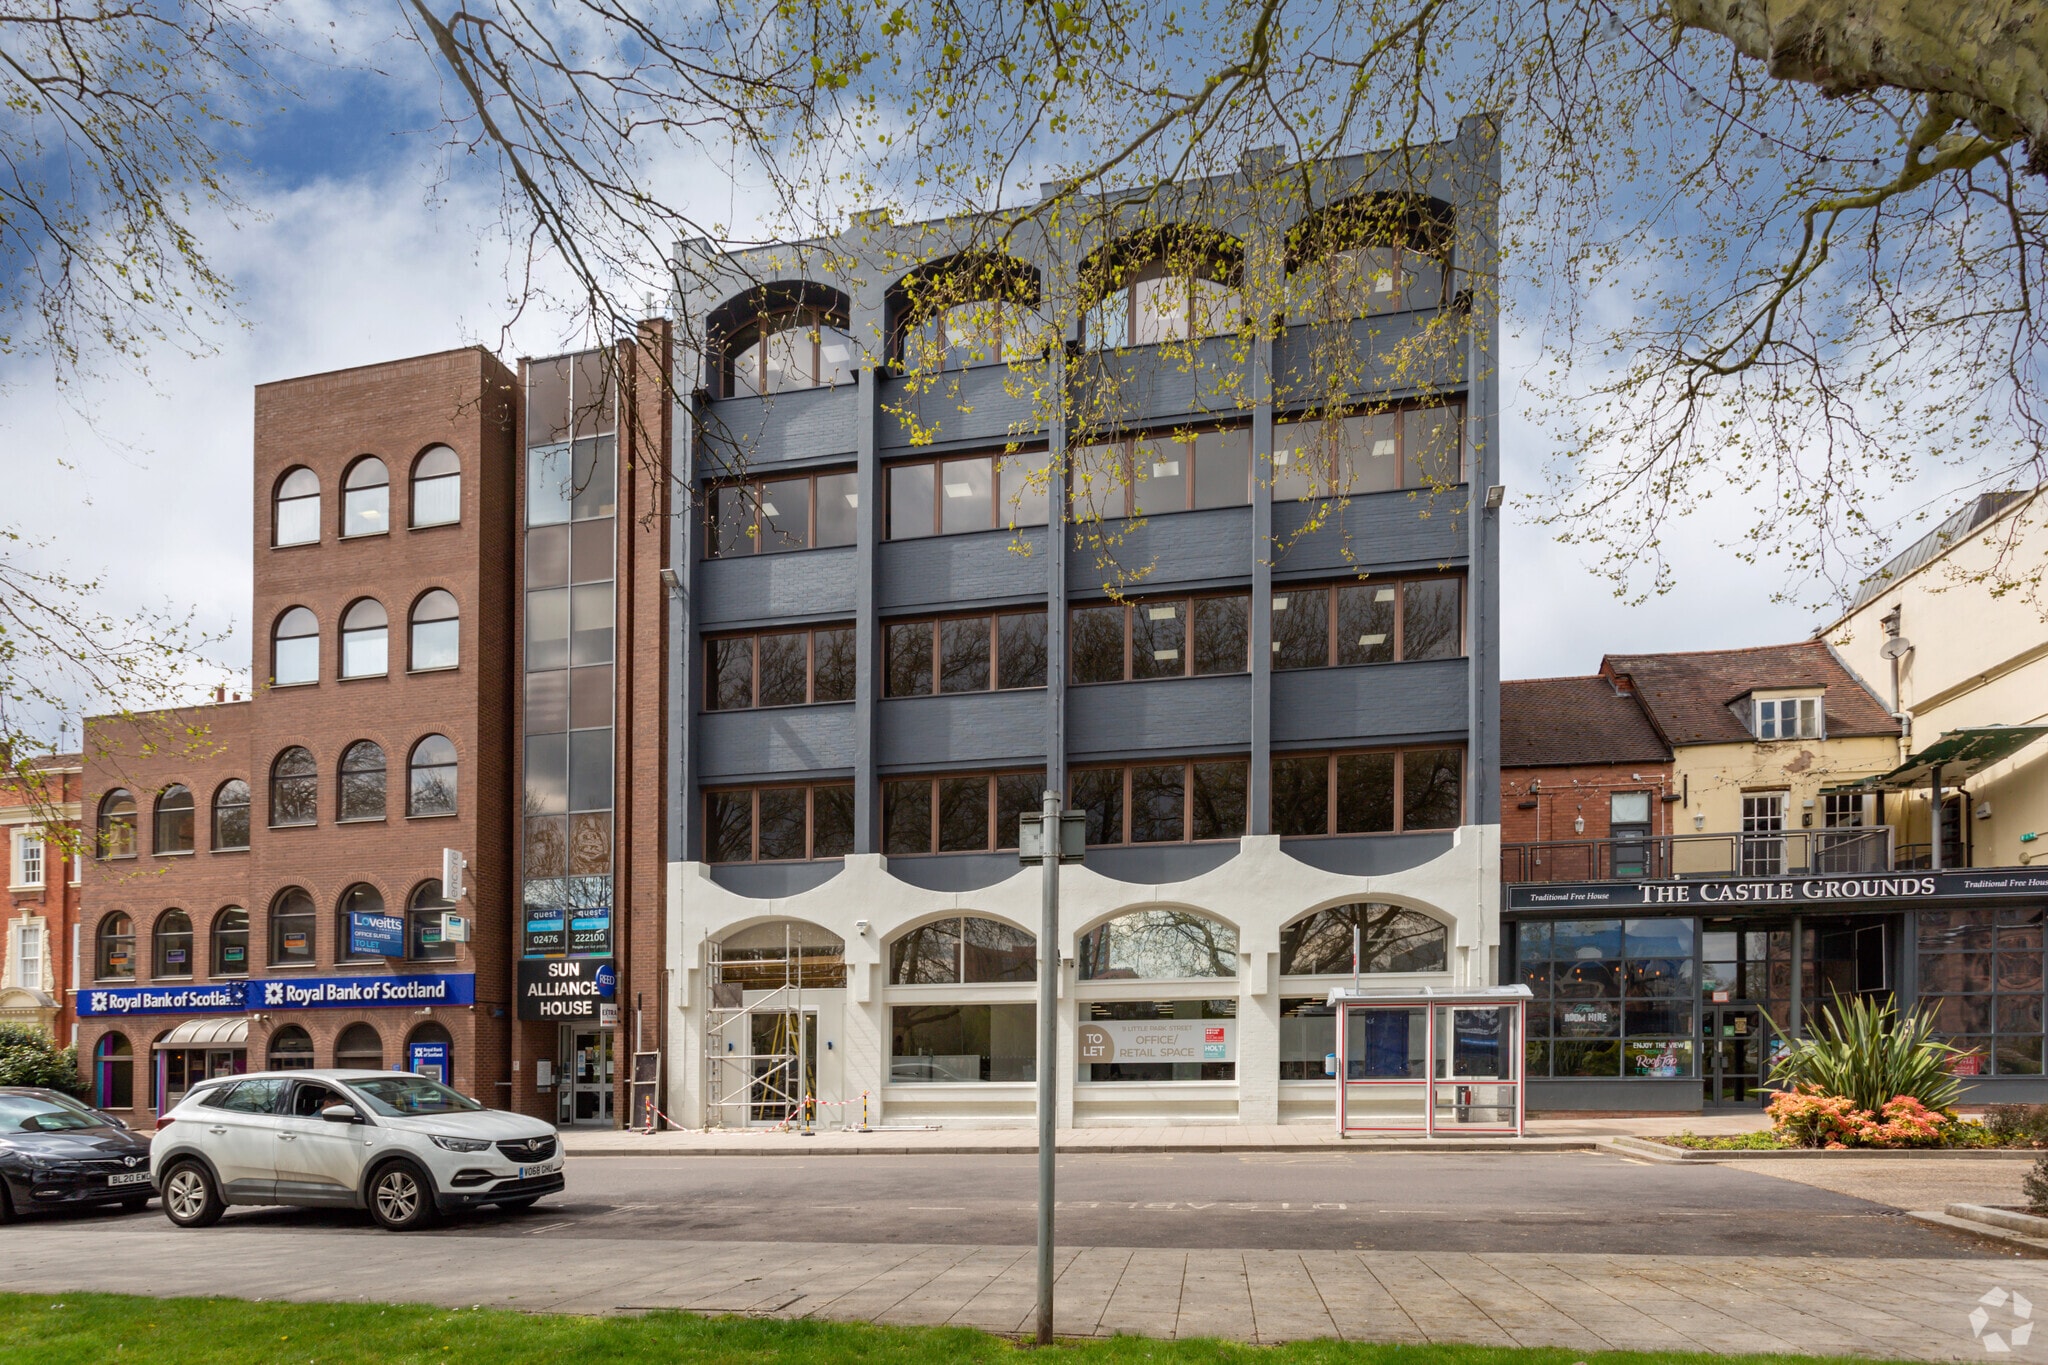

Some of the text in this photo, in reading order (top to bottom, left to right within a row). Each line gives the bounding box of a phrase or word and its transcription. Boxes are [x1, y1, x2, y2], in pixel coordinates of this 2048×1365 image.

[451, 852, 459, 898] encore
[1964, 880, 2007, 889] Traditional
[1639, 878, 1936, 903] THE CASTLE GROUNDS
[1530, 892, 1609, 902] Traditional Free House
[534, 911, 557, 919] quest
[579, 909, 602, 917] quest
[354, 913, 402, 930] Loveitts
[534, 935, 559, 944] 02476
[575, 933, 605, 943] 222100
[355, 939, 380, 949] TO LET
[549, 962, 580, 977] SUN
[600, 974, 615, 986] REED
[287, 980, 446, 1006] Royal Bank of Scotland
[527, 981, 601, 997] ALLIANCE
[109, 991, 227, 1013] Royal Bank of Scotla
[540, 1001, 593, 1016] HOUSE
[1588, 1013, 1608, 1023] HIRE
[1086, 1034, 1103, 1044] TO
[1136, 1034, 1179, 1045] OFFICE/
[1083, 1046, 1106, 1057] LET
[1120, 1049, 1156, 1058] RETAIL
[1160, 1048, 1195, 1057] SPACE
[525, 1166, 541, 1177] VO68
[112, 1175, 135, 1184] BL20
